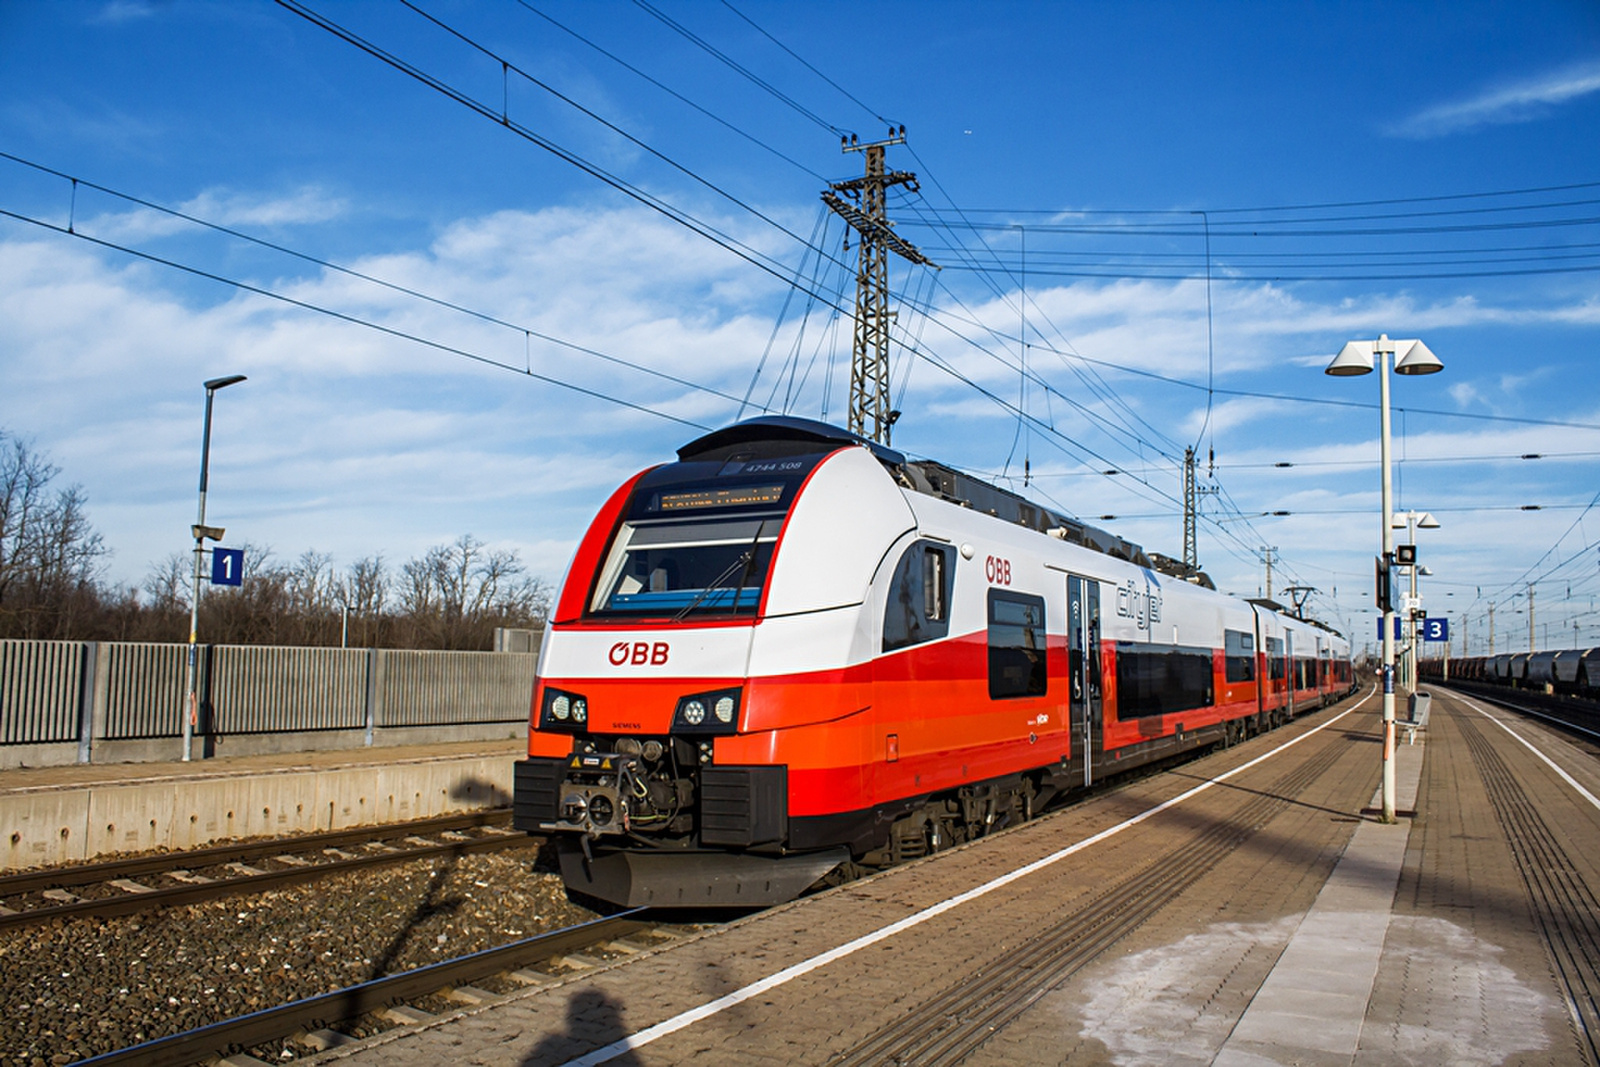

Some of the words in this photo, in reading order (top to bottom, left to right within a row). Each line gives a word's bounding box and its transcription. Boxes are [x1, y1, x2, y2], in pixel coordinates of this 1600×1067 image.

[746, 463, 776, 473] 4744
[778, 462, 803, 470] 508
[222, 555, 232, 578] 1
[986, 555, 1011, 586] ÖBB
[1430, 622, 1442, 638] 3
[609, 642, 670, 666] ÖBB
